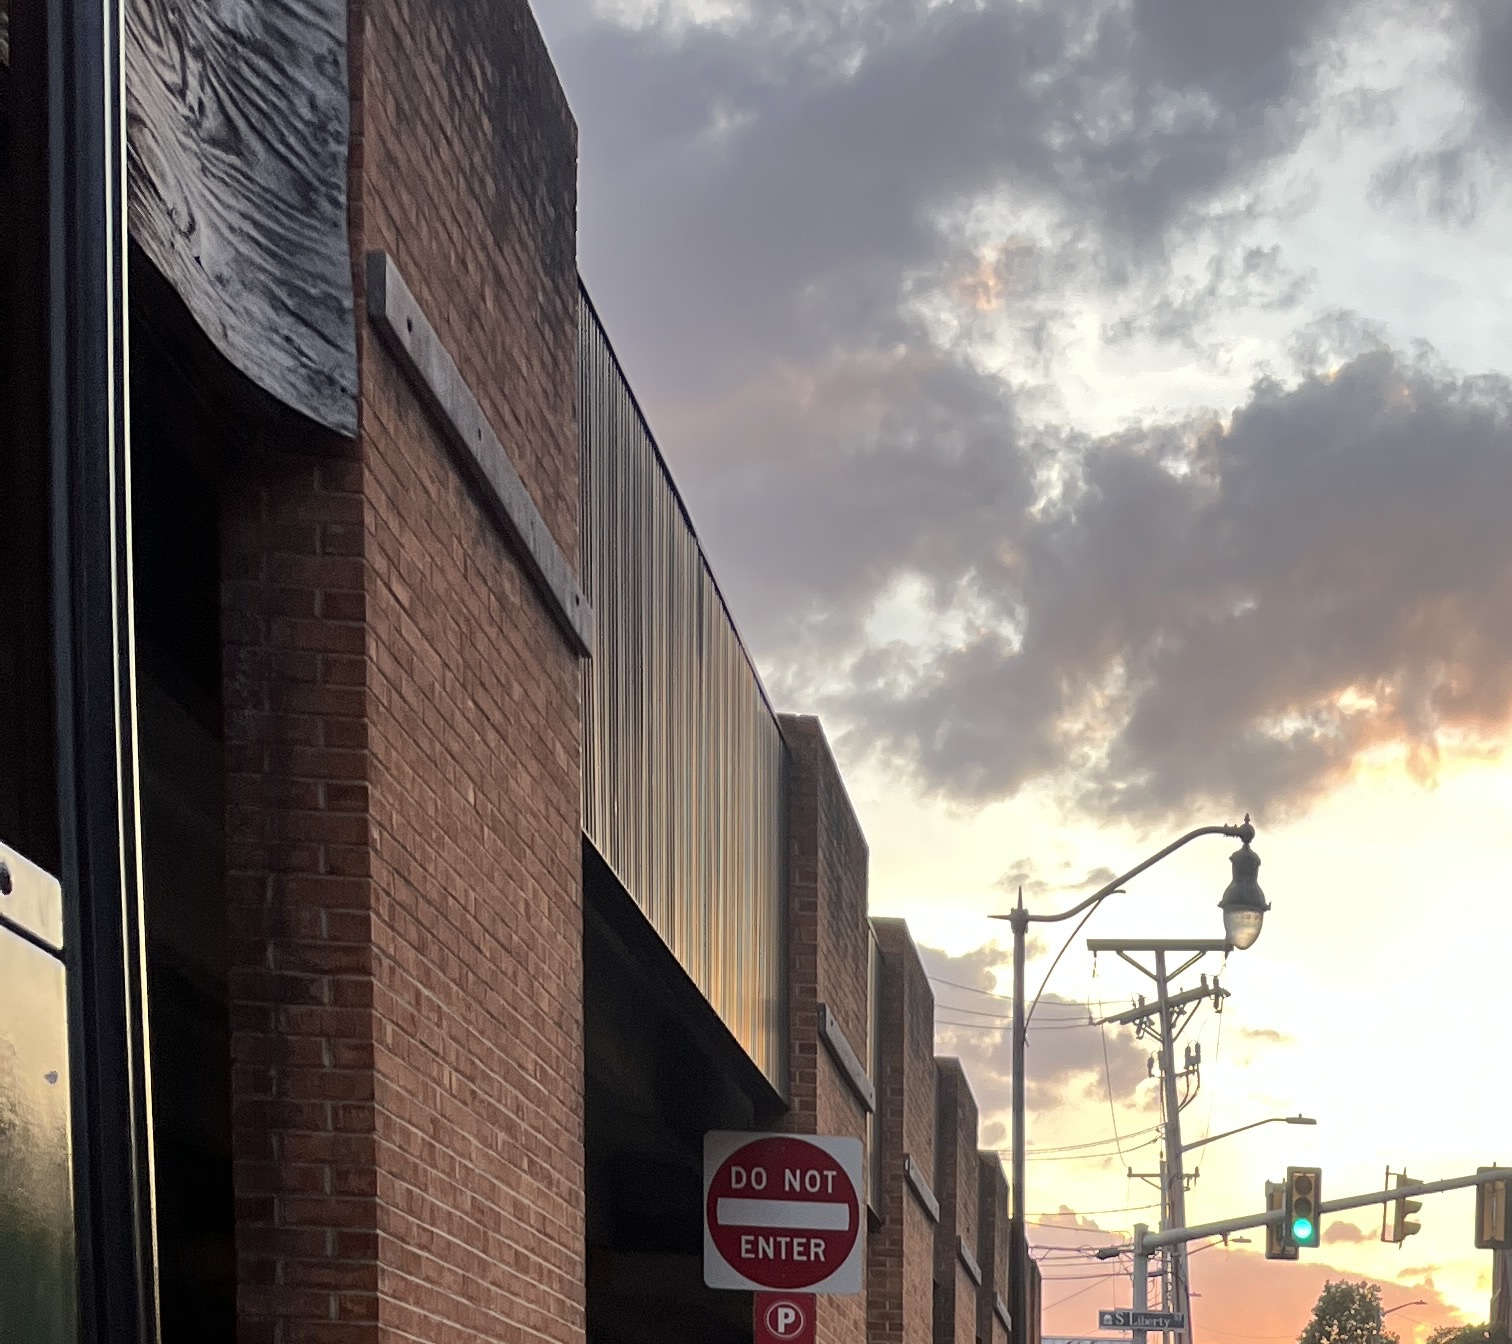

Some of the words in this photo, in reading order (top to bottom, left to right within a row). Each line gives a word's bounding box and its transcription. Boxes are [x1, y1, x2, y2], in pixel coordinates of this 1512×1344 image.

[730, 1165, 768, 1191] DO
[783, 1168, 838, 1194] NOT
[739, 1234, 827, 1262] ENTER
[776, 1307, 796, 1333] P
[1115, 1312, 1124, 1326] S
[1129, 1312, 1171, 1329] Liberty
